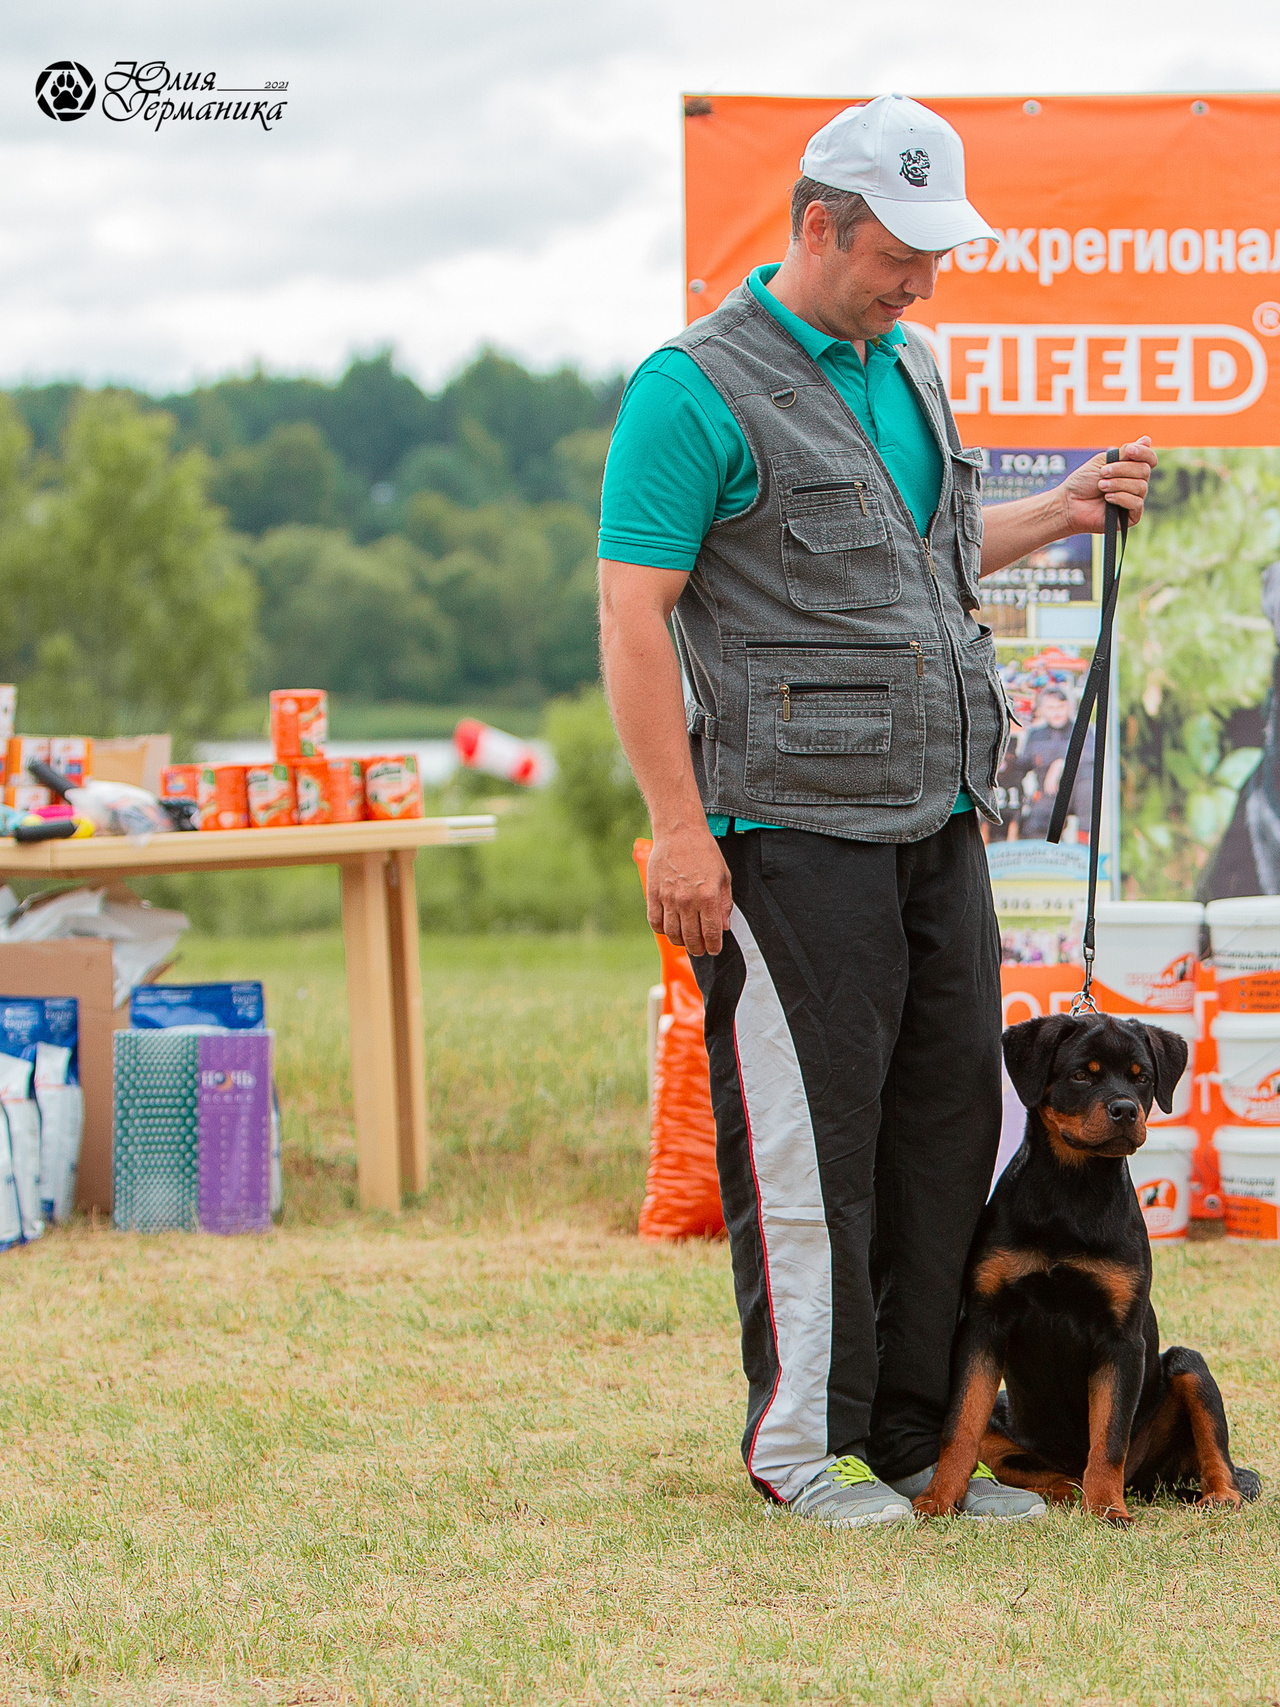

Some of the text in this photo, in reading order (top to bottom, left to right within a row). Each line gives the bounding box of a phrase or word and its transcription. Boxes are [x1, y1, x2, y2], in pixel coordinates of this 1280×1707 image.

[936, 324, 1267, 414] FIFEED
[1000, 453, 1067, 477] года
[980, 588, 1072, 610] татусом
